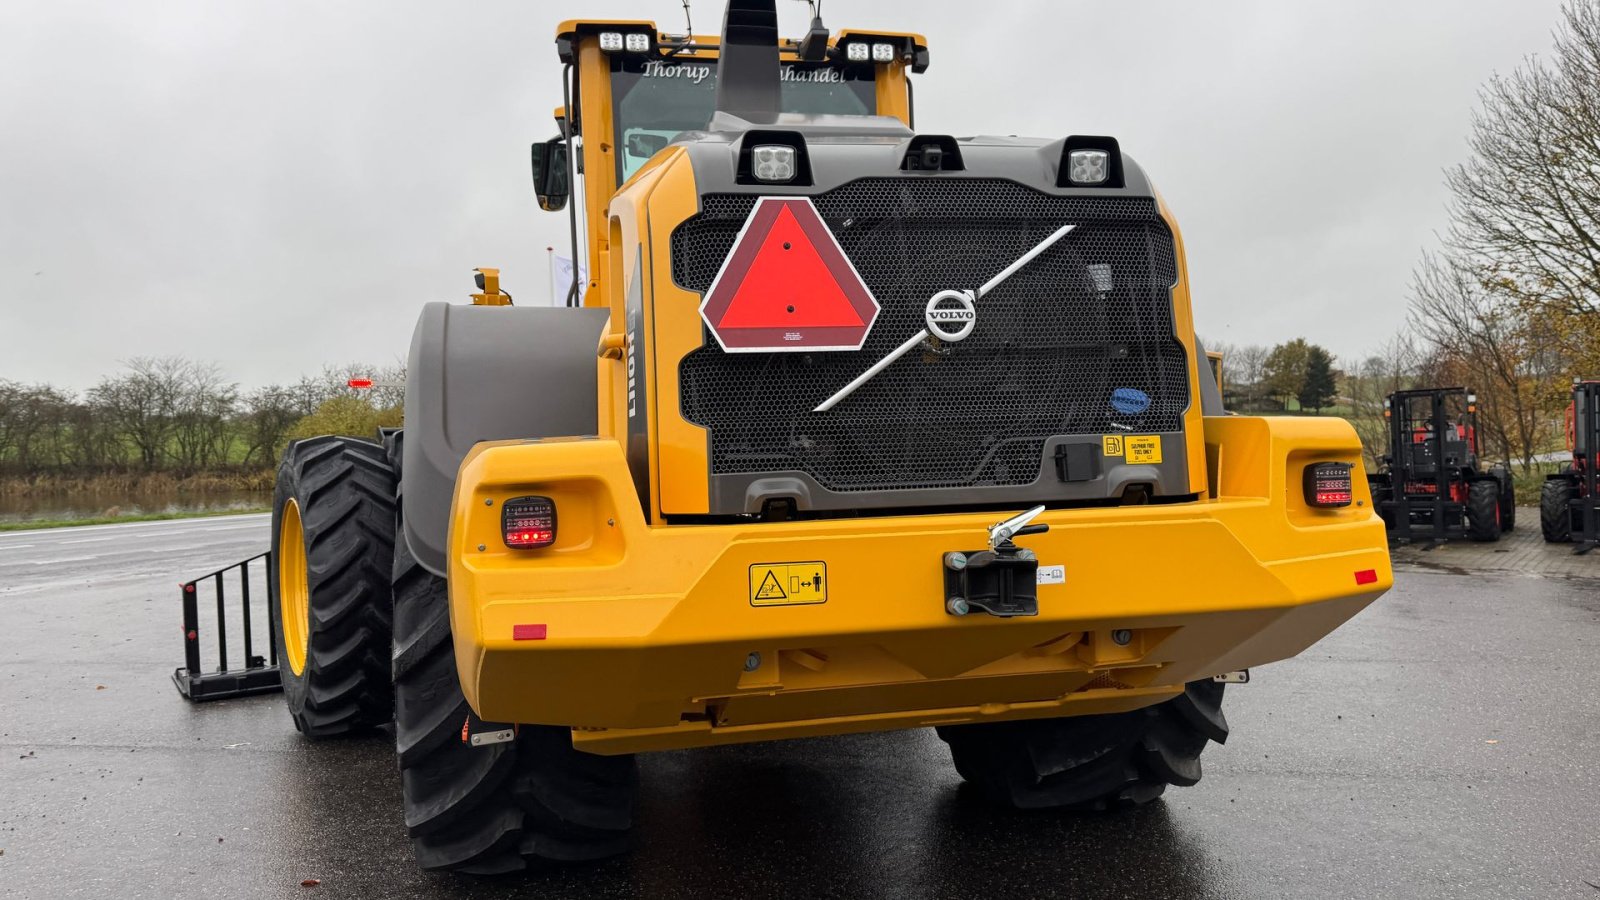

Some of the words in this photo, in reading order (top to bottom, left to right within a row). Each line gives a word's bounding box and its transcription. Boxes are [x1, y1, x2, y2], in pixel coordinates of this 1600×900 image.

[640, 59, 710, 84] Thorup
[928, 311, 974, 319] VOLVO
[627, 331, 636, 418] L110H
